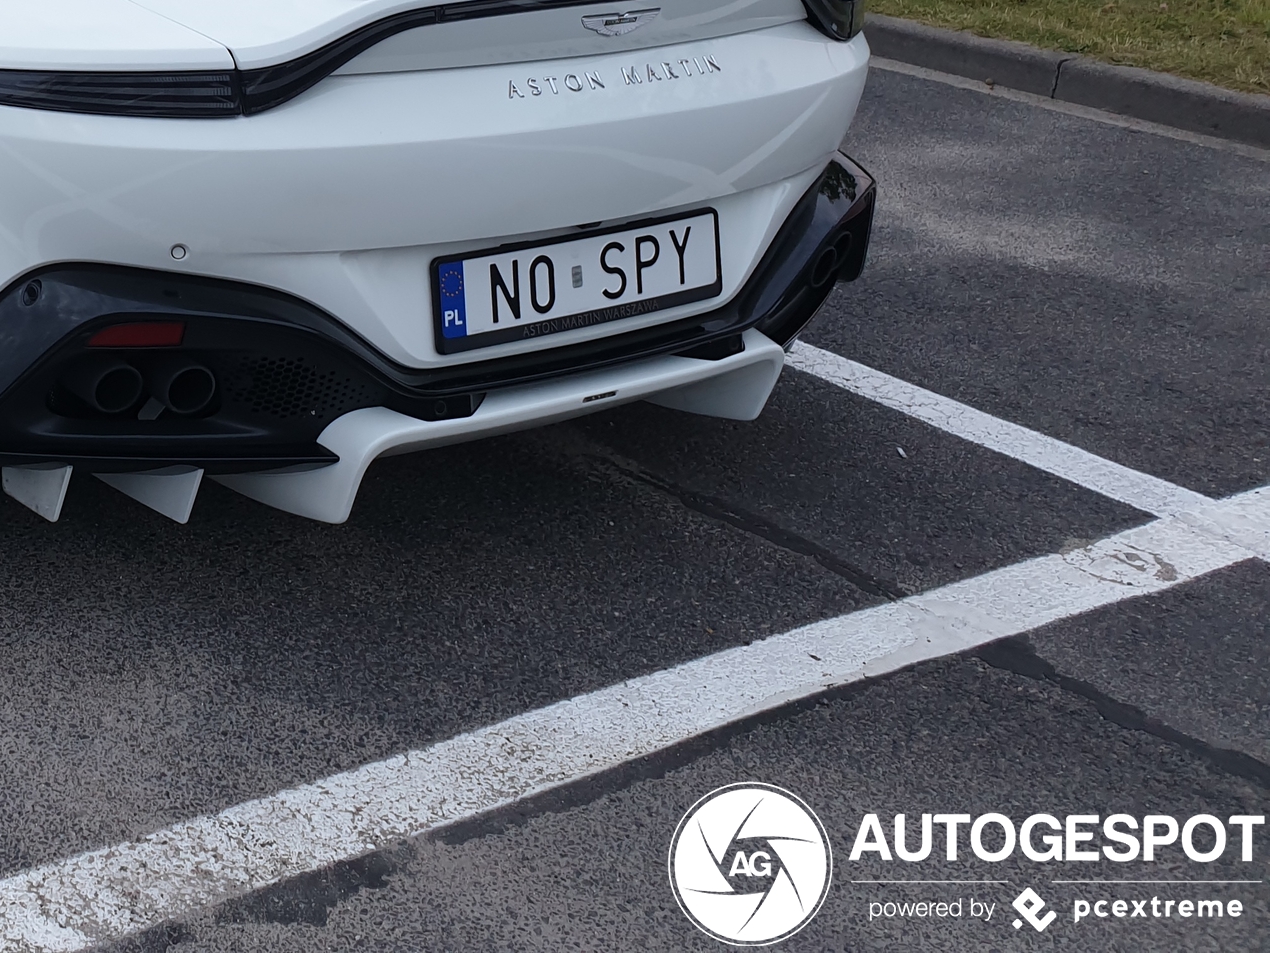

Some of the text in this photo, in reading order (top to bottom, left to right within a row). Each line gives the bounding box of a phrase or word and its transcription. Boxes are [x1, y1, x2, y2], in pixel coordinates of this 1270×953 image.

[508, 54, 722, 99] ASTON MARTIN
[489, 226, 692, 324] NO SPY
[444, 309, 463, 328] PL
[523, 299, 660, 338] ASTON MARTIN WARSZAWA
